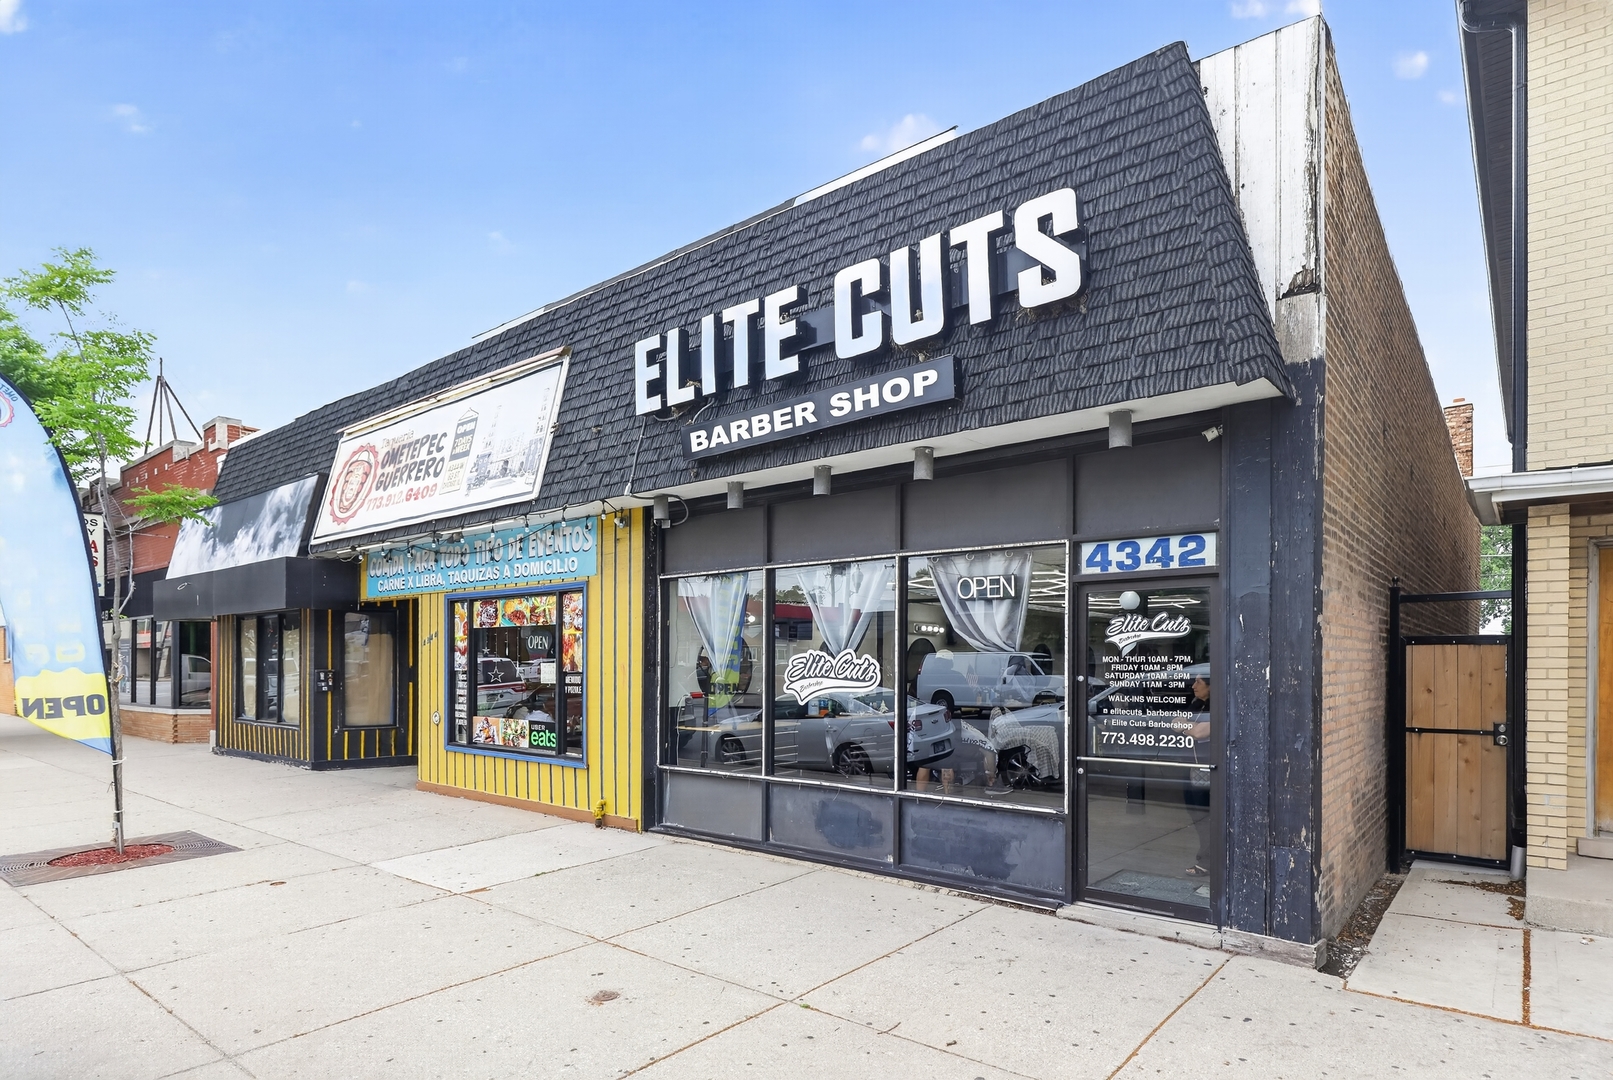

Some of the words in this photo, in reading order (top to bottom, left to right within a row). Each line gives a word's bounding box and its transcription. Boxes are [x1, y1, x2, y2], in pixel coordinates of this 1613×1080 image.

[635, 285, 800, 416] ELITE
[834, 187, 1083, 360] CUTS
[689, 400, 818, 453] BARBER
[829, 368, 939, 418] SHOP
[381, 432, 448, 469] OMETEPEC
[375, 456, 445, 492] GUERRERO
[369, 554, 405, 578] COMIDA
[407, 548, 436, 574] PARA
[440, 543, 470, 569] TODO
[474, 536, 503, 566] TIPO
[508, 533, 524, 561] DE
[528, 522, 594, 558] EVENTOS
[1085, 534, 1206, 573] 4342
[378, 577, 406, 592] CARNE
[407, 576, 414, 589] X
[416, 573, 446, 588] LIBRA,
[448, 565, 500, 585] TAQUIZAS
[503, 565, 511, 579] A
[514, 557, 578, 578] DOMICILIO
[957, 575, 1016, 600] OPEN
[1106, 613, 1149, 636] Elite
[1151, 612, 1190, 633] Cuts
[527, 635, 549, 649] OPEN
[787, 652, 833, 682] Elite
[834, 651, 878, 682] Cuts
[1110, 708, 1193, 719] elitecuts_barbershop
[1148, 720, 1193, 730] Barbershop
[531, 729, 557, 747] eats
[1101, 731, 1194, 748] 773.498.2230
